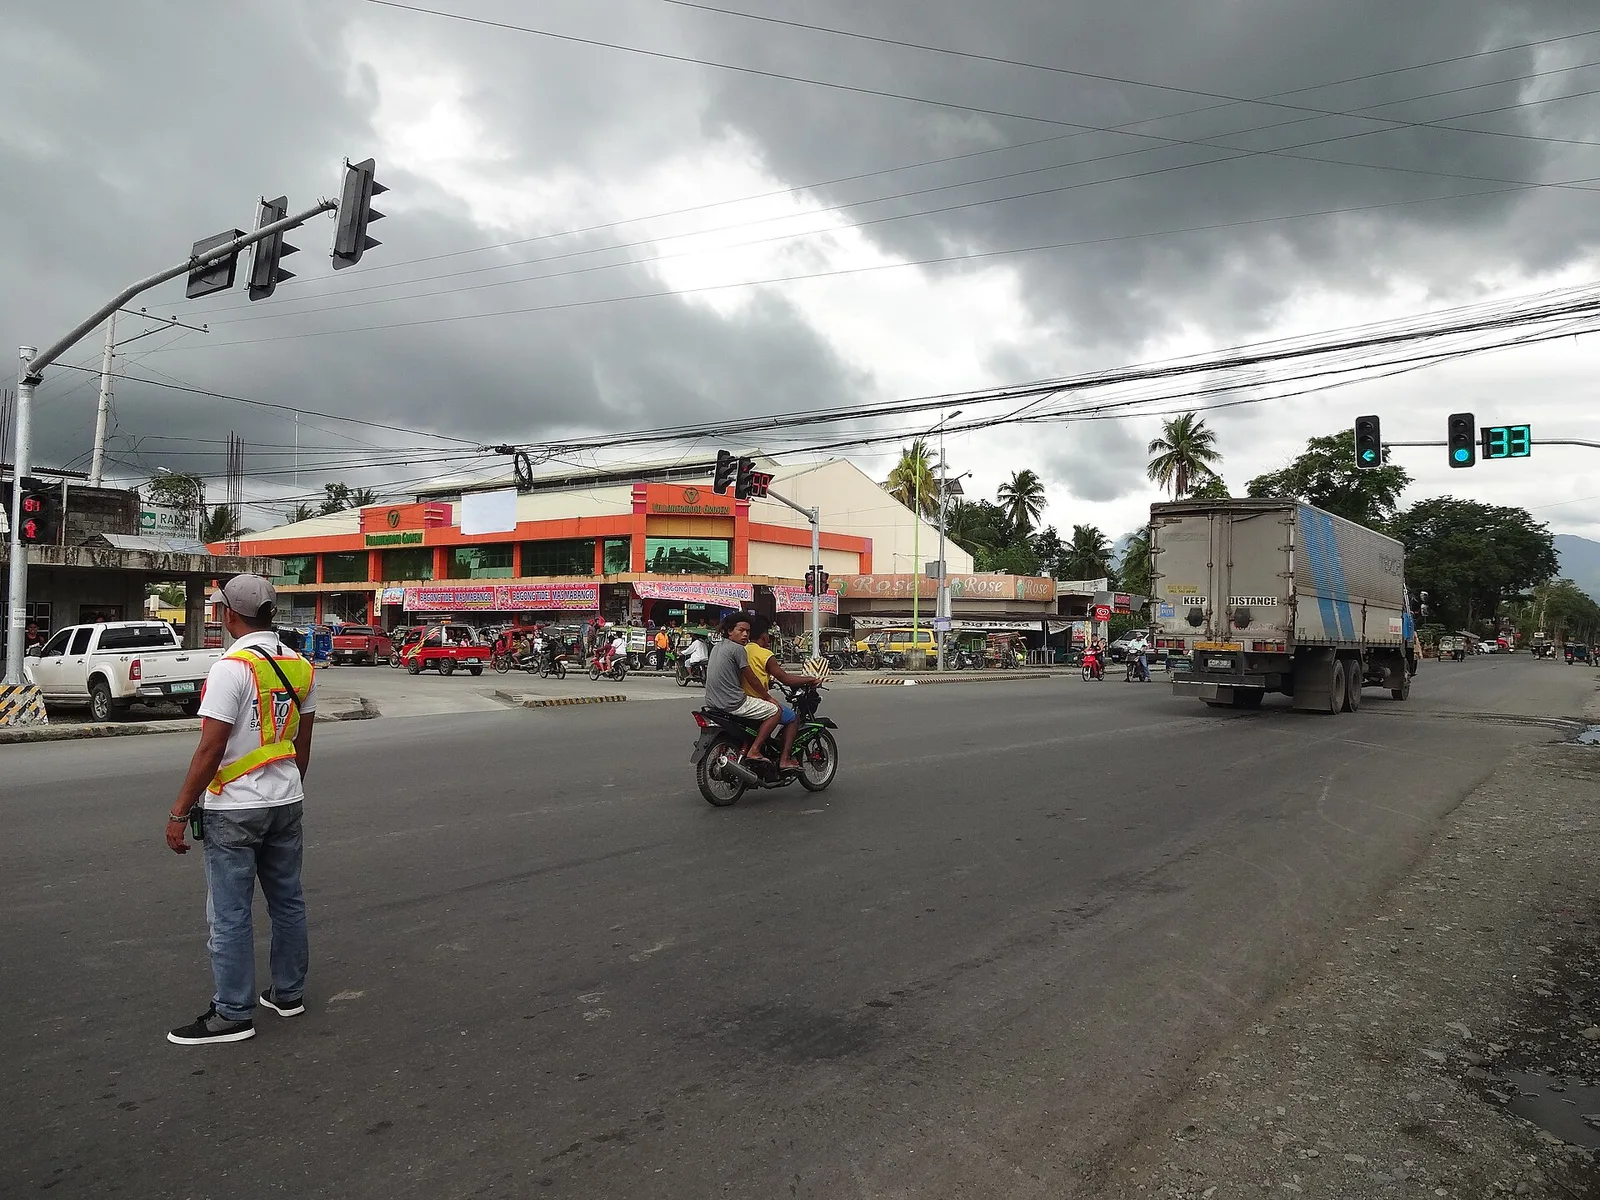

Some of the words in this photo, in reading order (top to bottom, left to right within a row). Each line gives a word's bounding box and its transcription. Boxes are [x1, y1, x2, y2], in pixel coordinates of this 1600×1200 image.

[1490, 426, 1529, 458] 33
[661, 585, 687, 593] BAGONG
[706, 587, 718, 595] MAS
[719, 588, 751, 600] MABANGO!
[853, 577, 915, 594] Rose
[964, 576, 1003, 594] Rose
[1025, 579, 1048, 596] Rose
[420, 593, 439, 602] BAGONG
[512, 591, 536, 601] BAGONG
[552, 590, 564, 600] MAS
[565, 589, 596, 600] MABANGO!
[1183, 596, 1207, 606] KEEP
[1229, 596, 1277, 606] DISTANCE
[862, 619, 883, 627] Big
